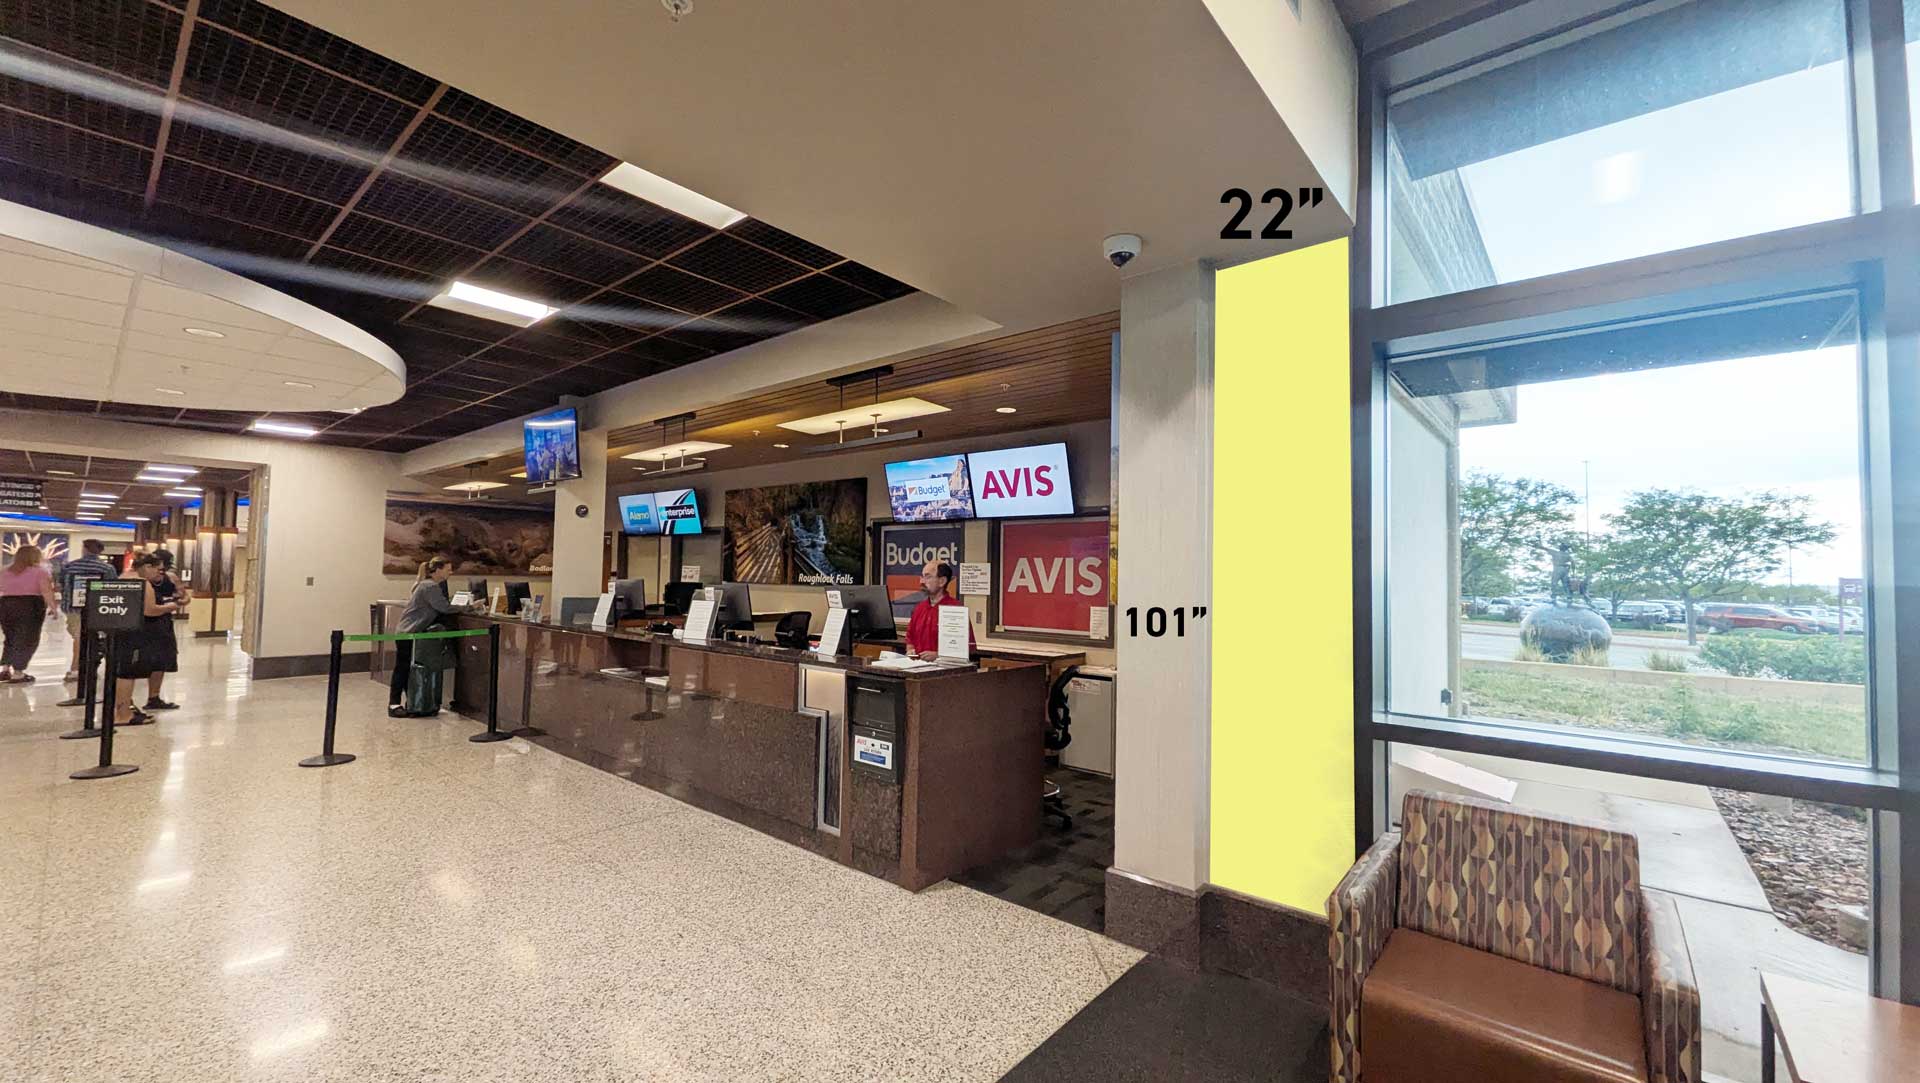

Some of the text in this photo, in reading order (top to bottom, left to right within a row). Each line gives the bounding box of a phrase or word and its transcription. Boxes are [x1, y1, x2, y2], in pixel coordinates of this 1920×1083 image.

[982, 465, 1054, 499] AVIS
[918, 485, 945, 496] Budget
[886, 542, 958, 566] Budget
[798, 572, 854, 585] Roughlock Falls
[1007, 556, 1103, 597] AVIS
[100, 595, 124, 604] Exit
[99, 605, 128, 616] Only
